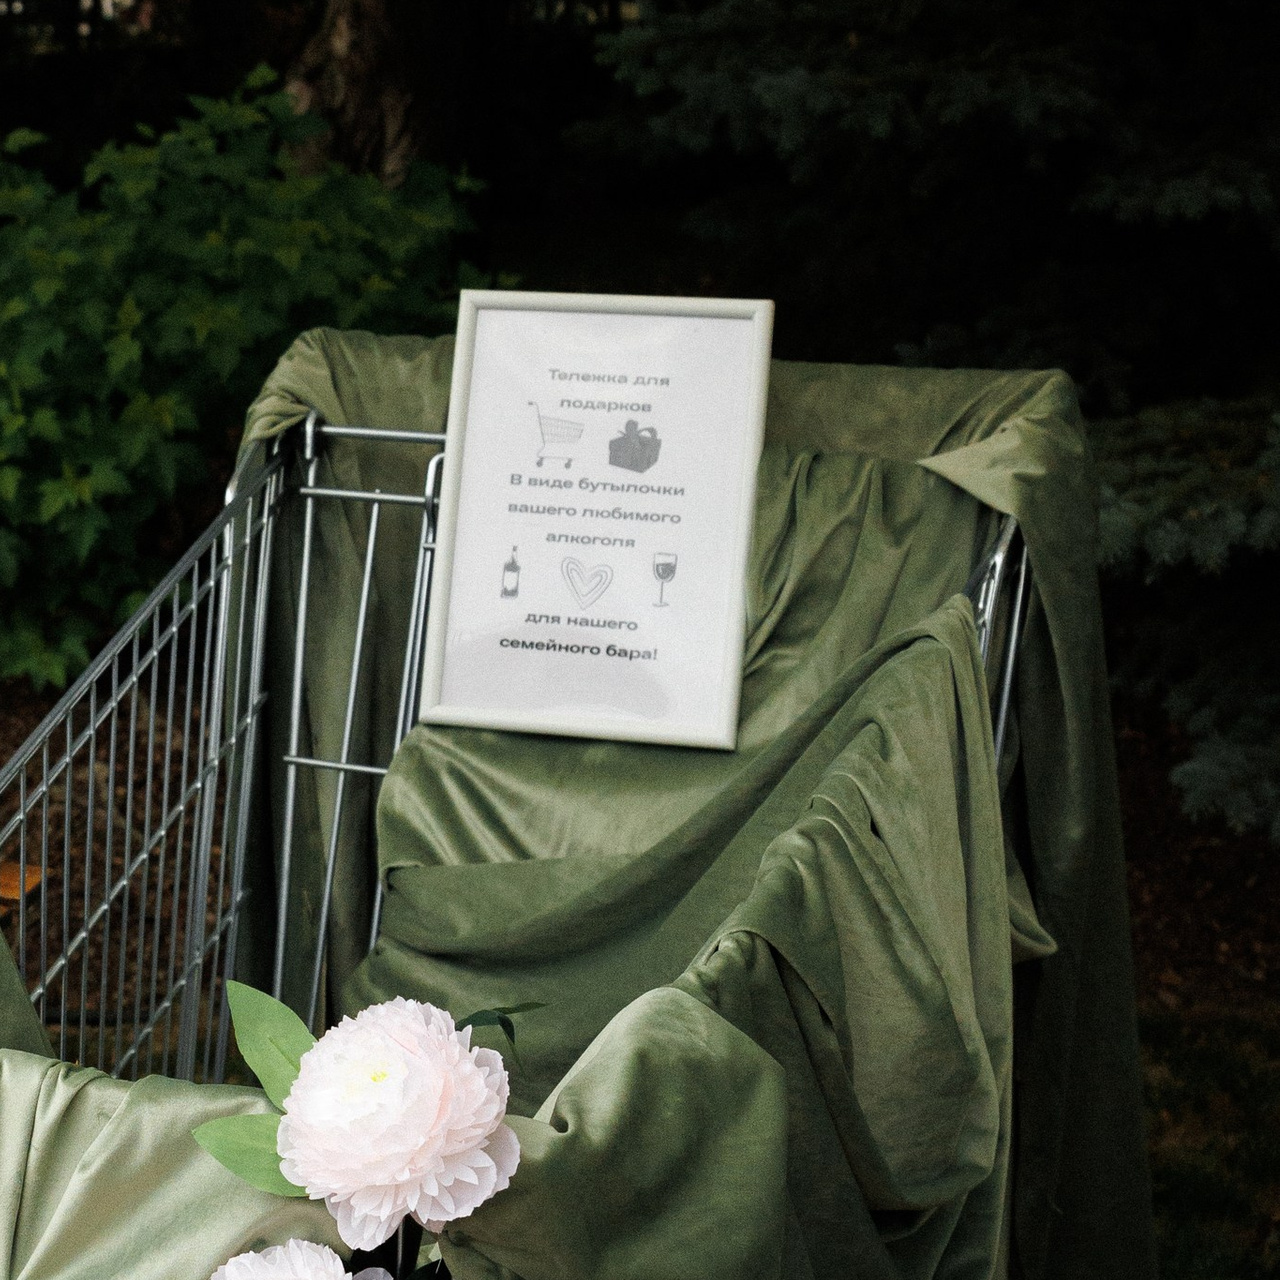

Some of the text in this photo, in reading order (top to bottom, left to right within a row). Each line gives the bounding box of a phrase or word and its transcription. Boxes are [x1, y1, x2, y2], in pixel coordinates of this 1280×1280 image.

[549, 369, 670, 387] Тележка для
[560, 398, 652, 413] подарков
[510, 474, 685, 496] В виде бутылочки
[508, 503, 681, 524] вашего любимого
[546, 532, 635, 548] алкоголя
[525, 613, 638, 631] для нашего
[499, 637, 658, 661] семейного бара!
